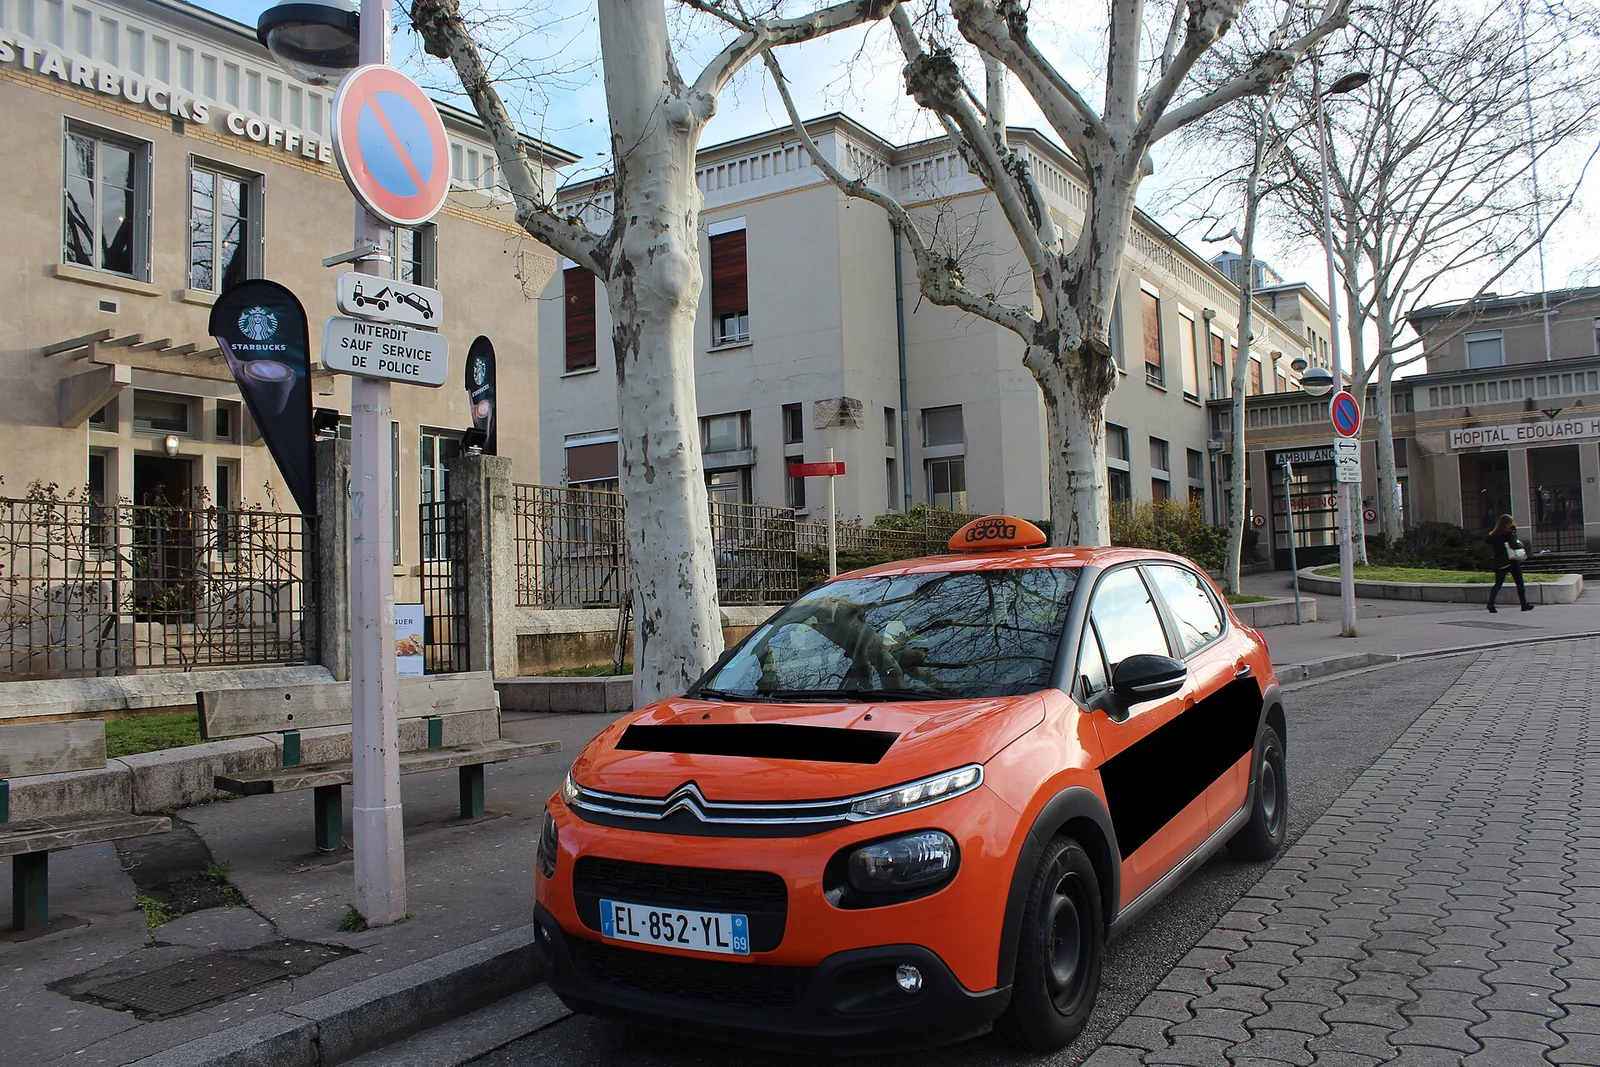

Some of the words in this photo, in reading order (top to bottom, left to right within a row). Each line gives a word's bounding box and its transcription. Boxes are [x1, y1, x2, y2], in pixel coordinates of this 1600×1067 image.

[0, 38, 210, 124] STARBUCKS
[227, 111, 332, 164] COFFEE
[354, 322, 409, 342] INTERDIT
[231, 343, 286, 351] STARBUCKS
[340, 337, 373, 352] SAUF
[381, 343, 432, 362] SERVICE
[351, 355, 368, 368] DE
[378, 359, 420, 376] POLICE
[1453, 429, 1510, 446] HOPITAL
[1516, 422, 1584, 440] EDOUARD
[966, 525, 1016, 542] ECOLE
[615, 906, 729, 948] EL-852-YL
[733, 936, 747, 950] 69
